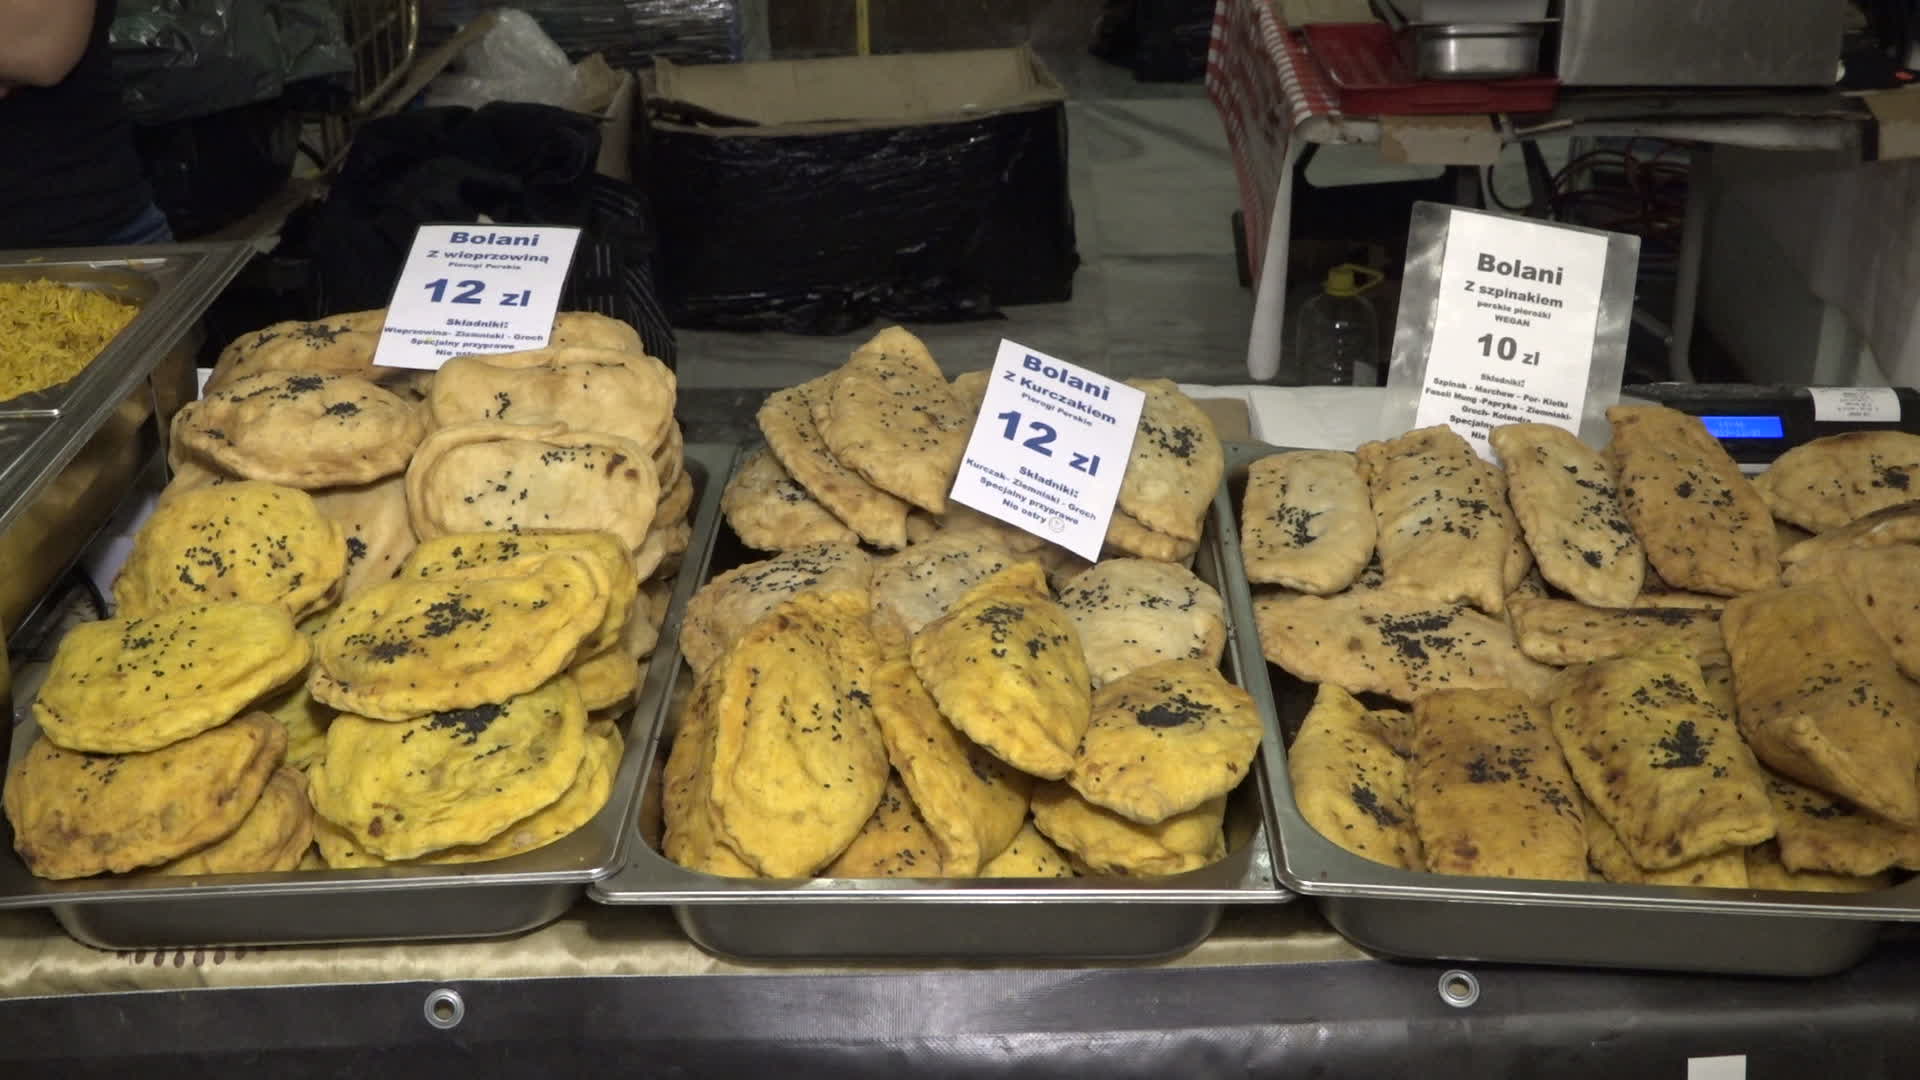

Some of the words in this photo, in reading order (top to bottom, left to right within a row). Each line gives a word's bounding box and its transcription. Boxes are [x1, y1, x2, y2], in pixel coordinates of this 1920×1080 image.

[450, 231, 540, 247] Bolani
[426, 250, 439, 258] Z
[1477, 252, 1563, 286] Bolani
[424, 278, 486, 304] 12
[1464, 280, 1475, 292] Z
[1479, 285, 1563, 308] szpinakiem
[1477, 301, 1512, 312] perskie
[1495, 314, 1530, 327] WEGAN
[410, 338, 460, 349] Specjalny
[1478, 333, 1517, 361] 10
[1023, 354, 1110, 400] Bolani
[1433, 377, 1467, 390] Szpinak
[1474, 385, 1515, 399] Marchew
[1003, 370, 1016, 382] Z
[1020, 377, 1117, 425] Kurczakiem
[1454, 392, 1477, 404] Mung
[998, 410, 1057, 457] 12
[1471, 431, 1487, 440] Nie
[980, 476, 1027, 502] Specjalny
[1012, 478, 1060, 504] Ziemniaki
[1068, 503, 1096, 521] Groch
[1002, 499, 1019, 511] Nie
[1021, 507, 1047, 524] ostry
